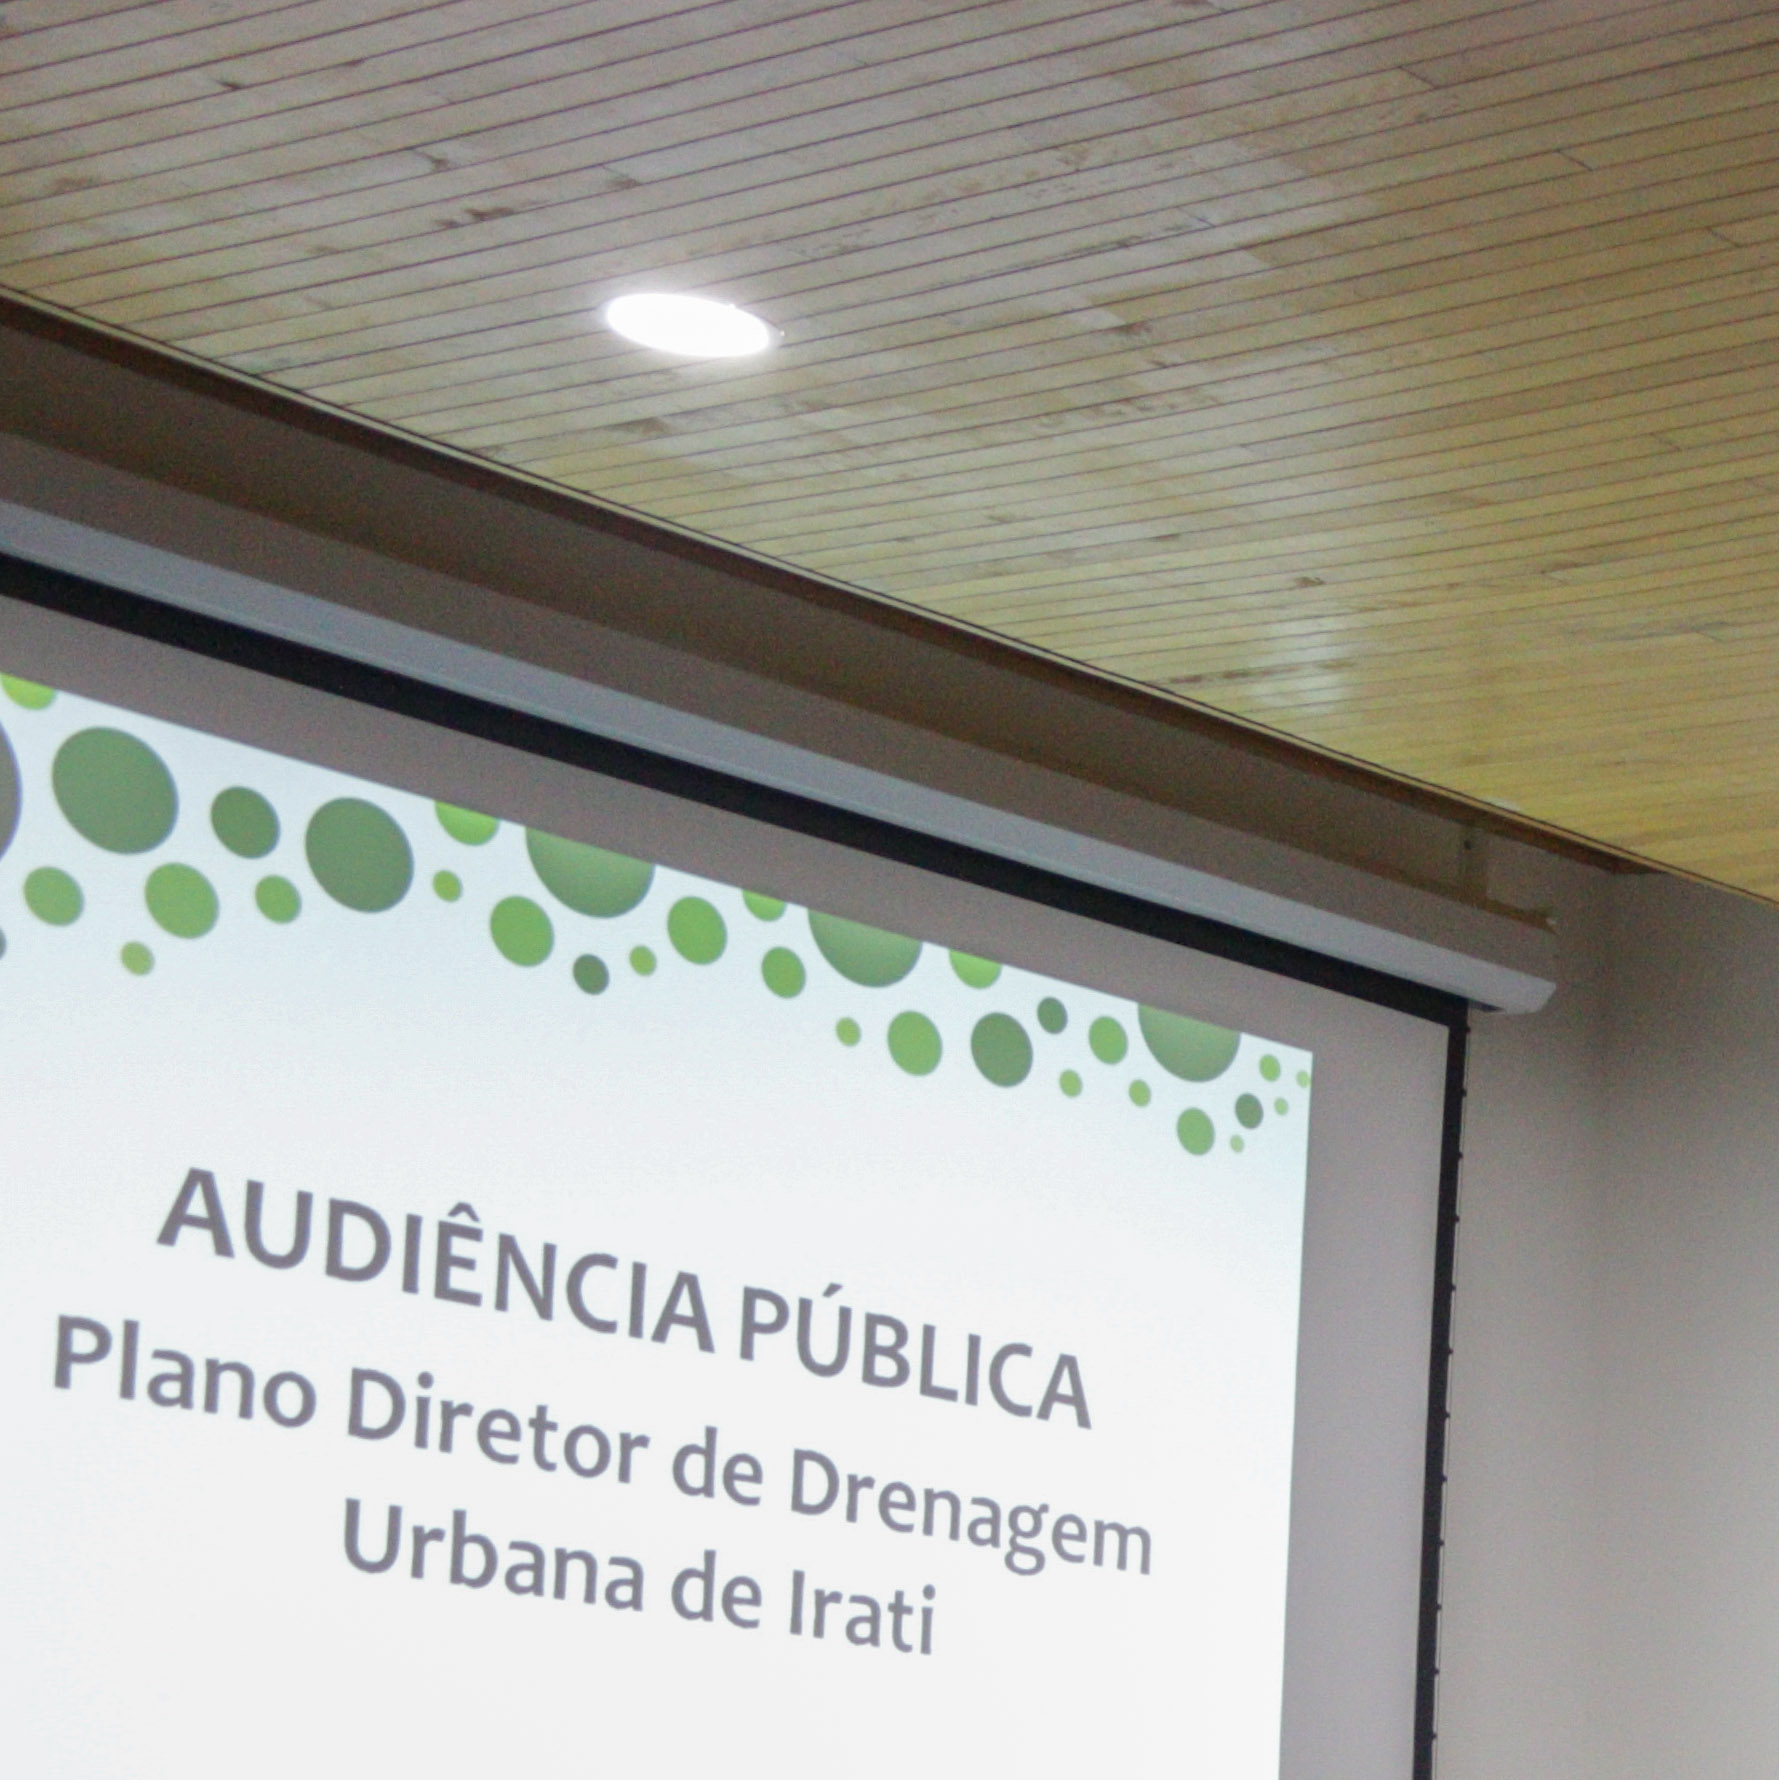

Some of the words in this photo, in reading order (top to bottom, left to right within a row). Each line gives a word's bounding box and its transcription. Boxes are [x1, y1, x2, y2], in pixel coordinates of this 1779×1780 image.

[156, 1167, 715, 1353] AUDIÊNCIA
[739, 1282, 1091, 1429] PÚBLICA
[54, 1315, 316, 1428] Plano
[347, 1367, 650, 1484] Diretor
[672, 1426, 763, 1506] de
[791, 1448, 1151, 1576] Drenagem
[344, 1498, 644, 1612] Urbana
[671, 1549, 762, 1629] de
[790, 1570, 936, 1655] Irati
